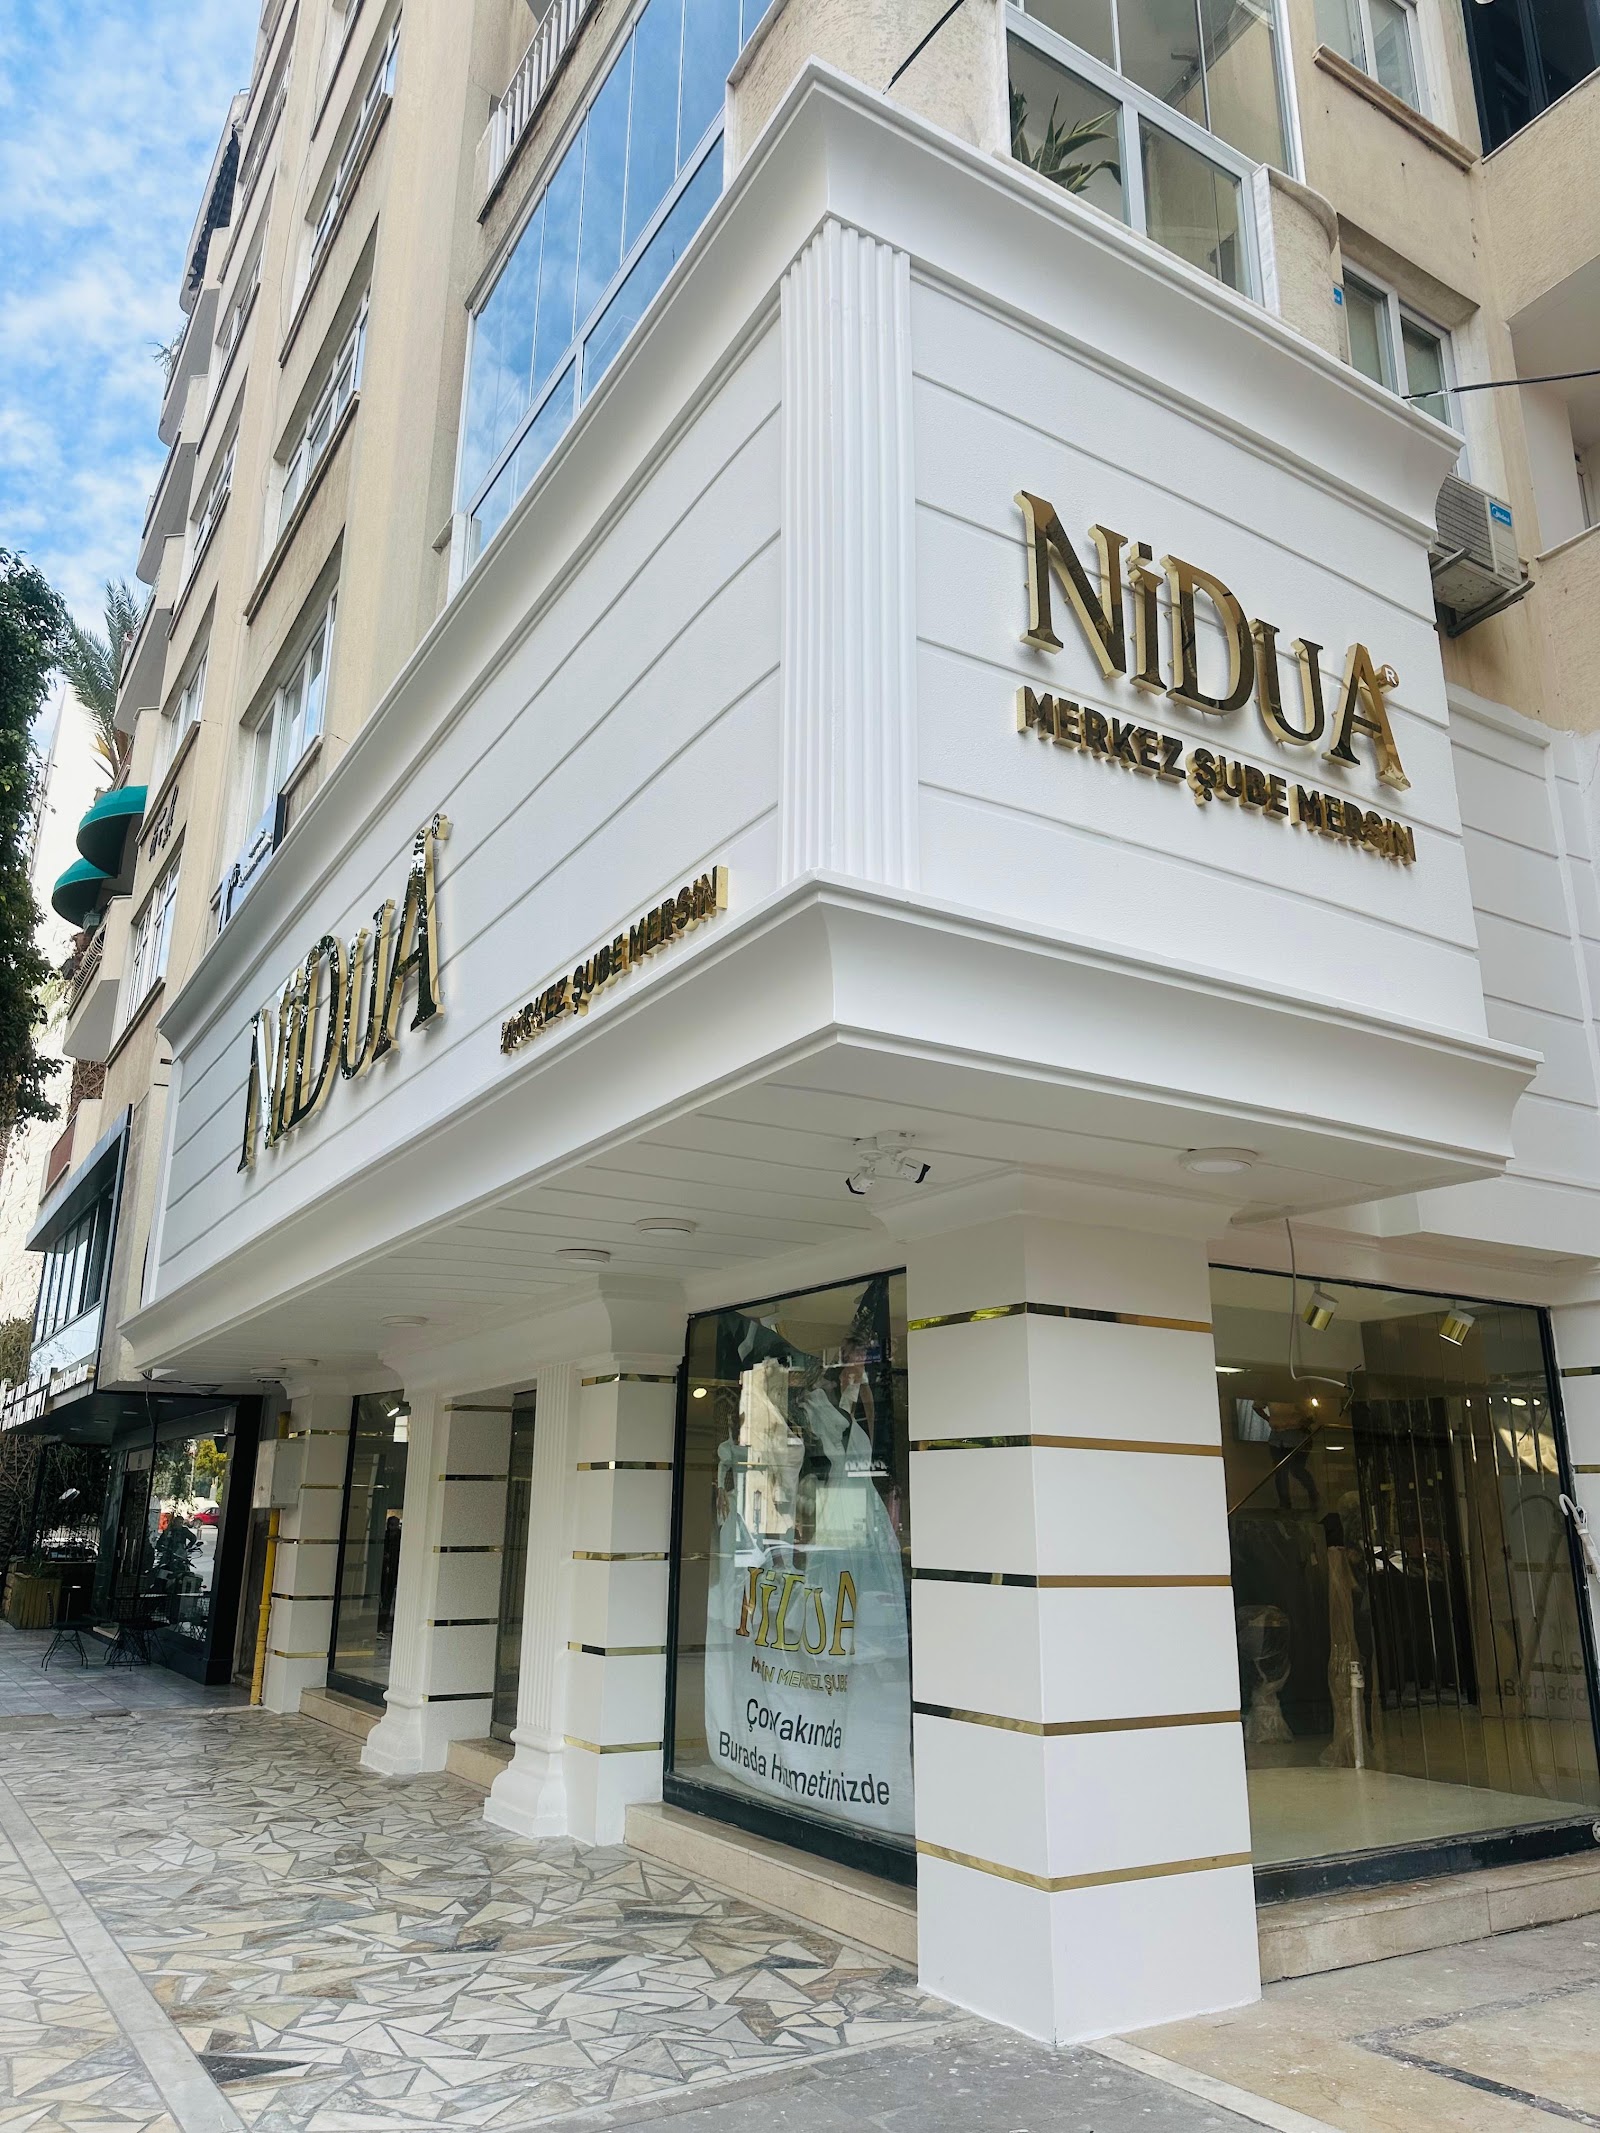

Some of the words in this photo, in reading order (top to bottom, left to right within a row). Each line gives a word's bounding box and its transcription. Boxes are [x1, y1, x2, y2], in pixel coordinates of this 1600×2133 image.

[1016, 685, 1187, 784] MERKEZ
[1185, 748, 1290, 818] ŞUBE
[719, 1731, 767, 1777] Burada
